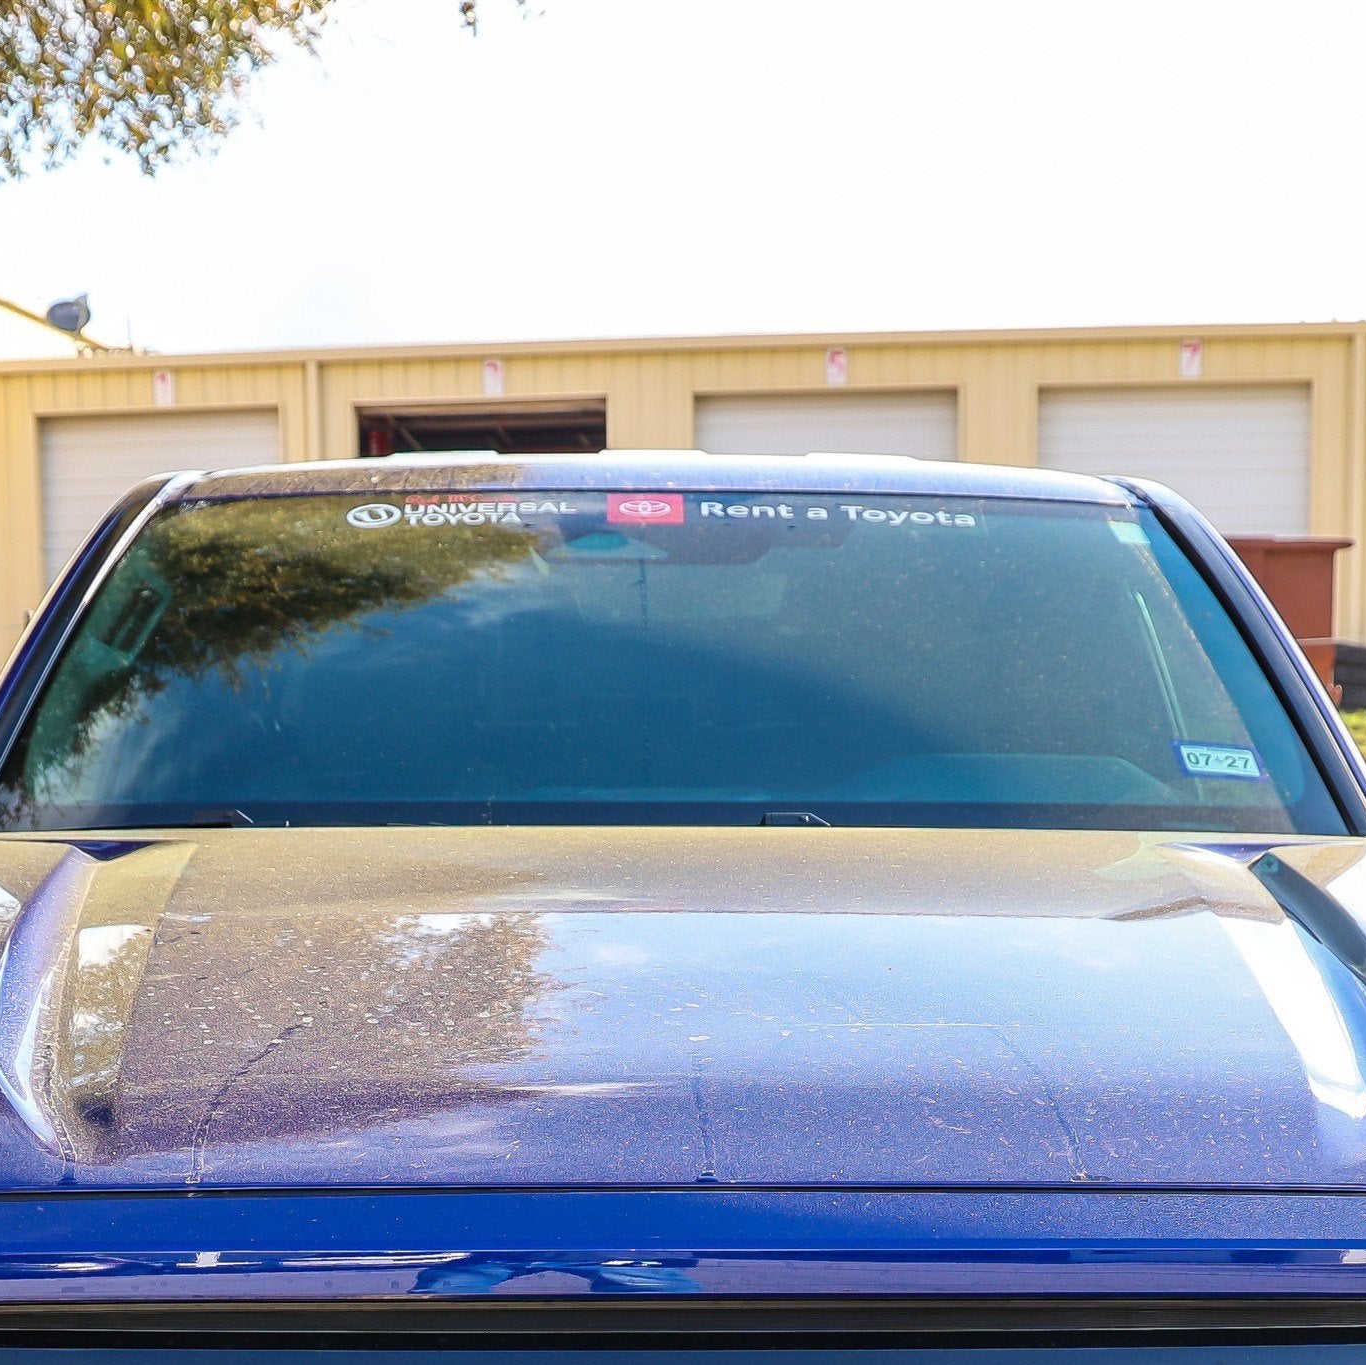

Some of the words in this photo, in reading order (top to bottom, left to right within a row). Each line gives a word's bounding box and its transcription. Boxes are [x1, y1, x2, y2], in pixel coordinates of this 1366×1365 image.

[403, 501, 577, 515] UNIVERSAL
[699, 501, 794, 519] Rent
[806, 505, 829, 521] a
[840, 504, 976, 528] Toyota
[403, 512, 522, 527] TOYOTA
